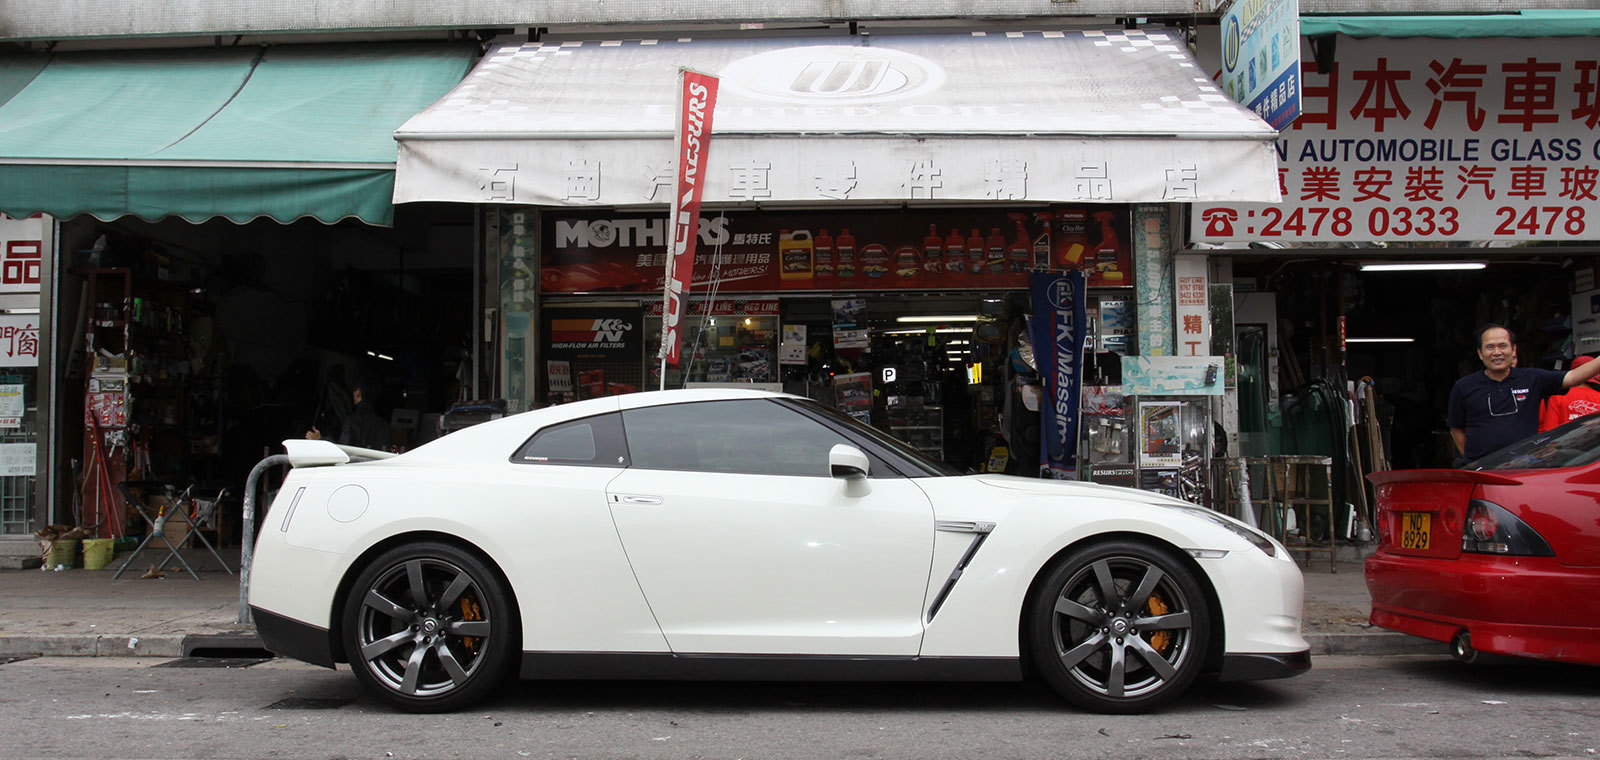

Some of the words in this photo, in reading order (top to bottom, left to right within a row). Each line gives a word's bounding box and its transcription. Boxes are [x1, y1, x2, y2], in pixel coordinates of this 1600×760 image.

[1299, 139, 1480, 162] AUTOMOBILE
[1491, 138, 1583, 162] GLASS
[555, 216, 730, 249] MOTHRS
[1368, 207, 1460, 236] 0333
[1494, 206, 1586, 235] 2478
[590, 318, 633, 343] K&N
[1410, 514, 1423, 531] ND
[1403, 531, 1428, 548] 8929
